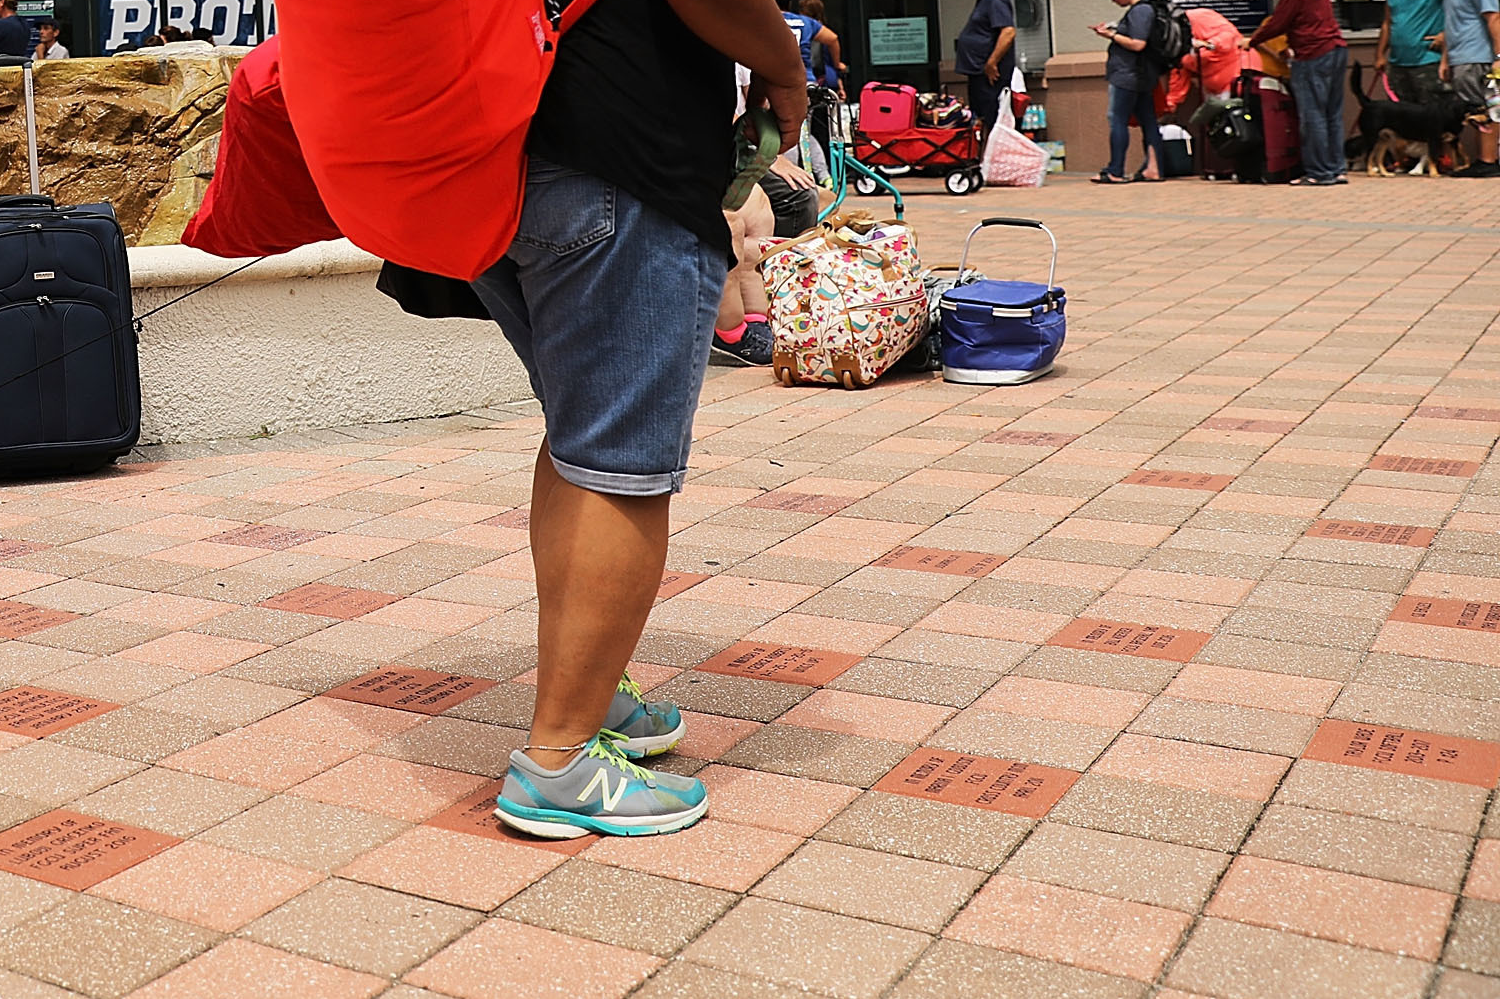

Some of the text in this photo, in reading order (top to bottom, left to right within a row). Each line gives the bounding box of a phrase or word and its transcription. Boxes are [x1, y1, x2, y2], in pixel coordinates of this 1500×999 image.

[9, 826, 65, 848] MEMORY
[60, 836, 102, 853] SUPER
[95, 826, 125, 837] FAN
[56, 835, 137, 870] AUGUST 2016
